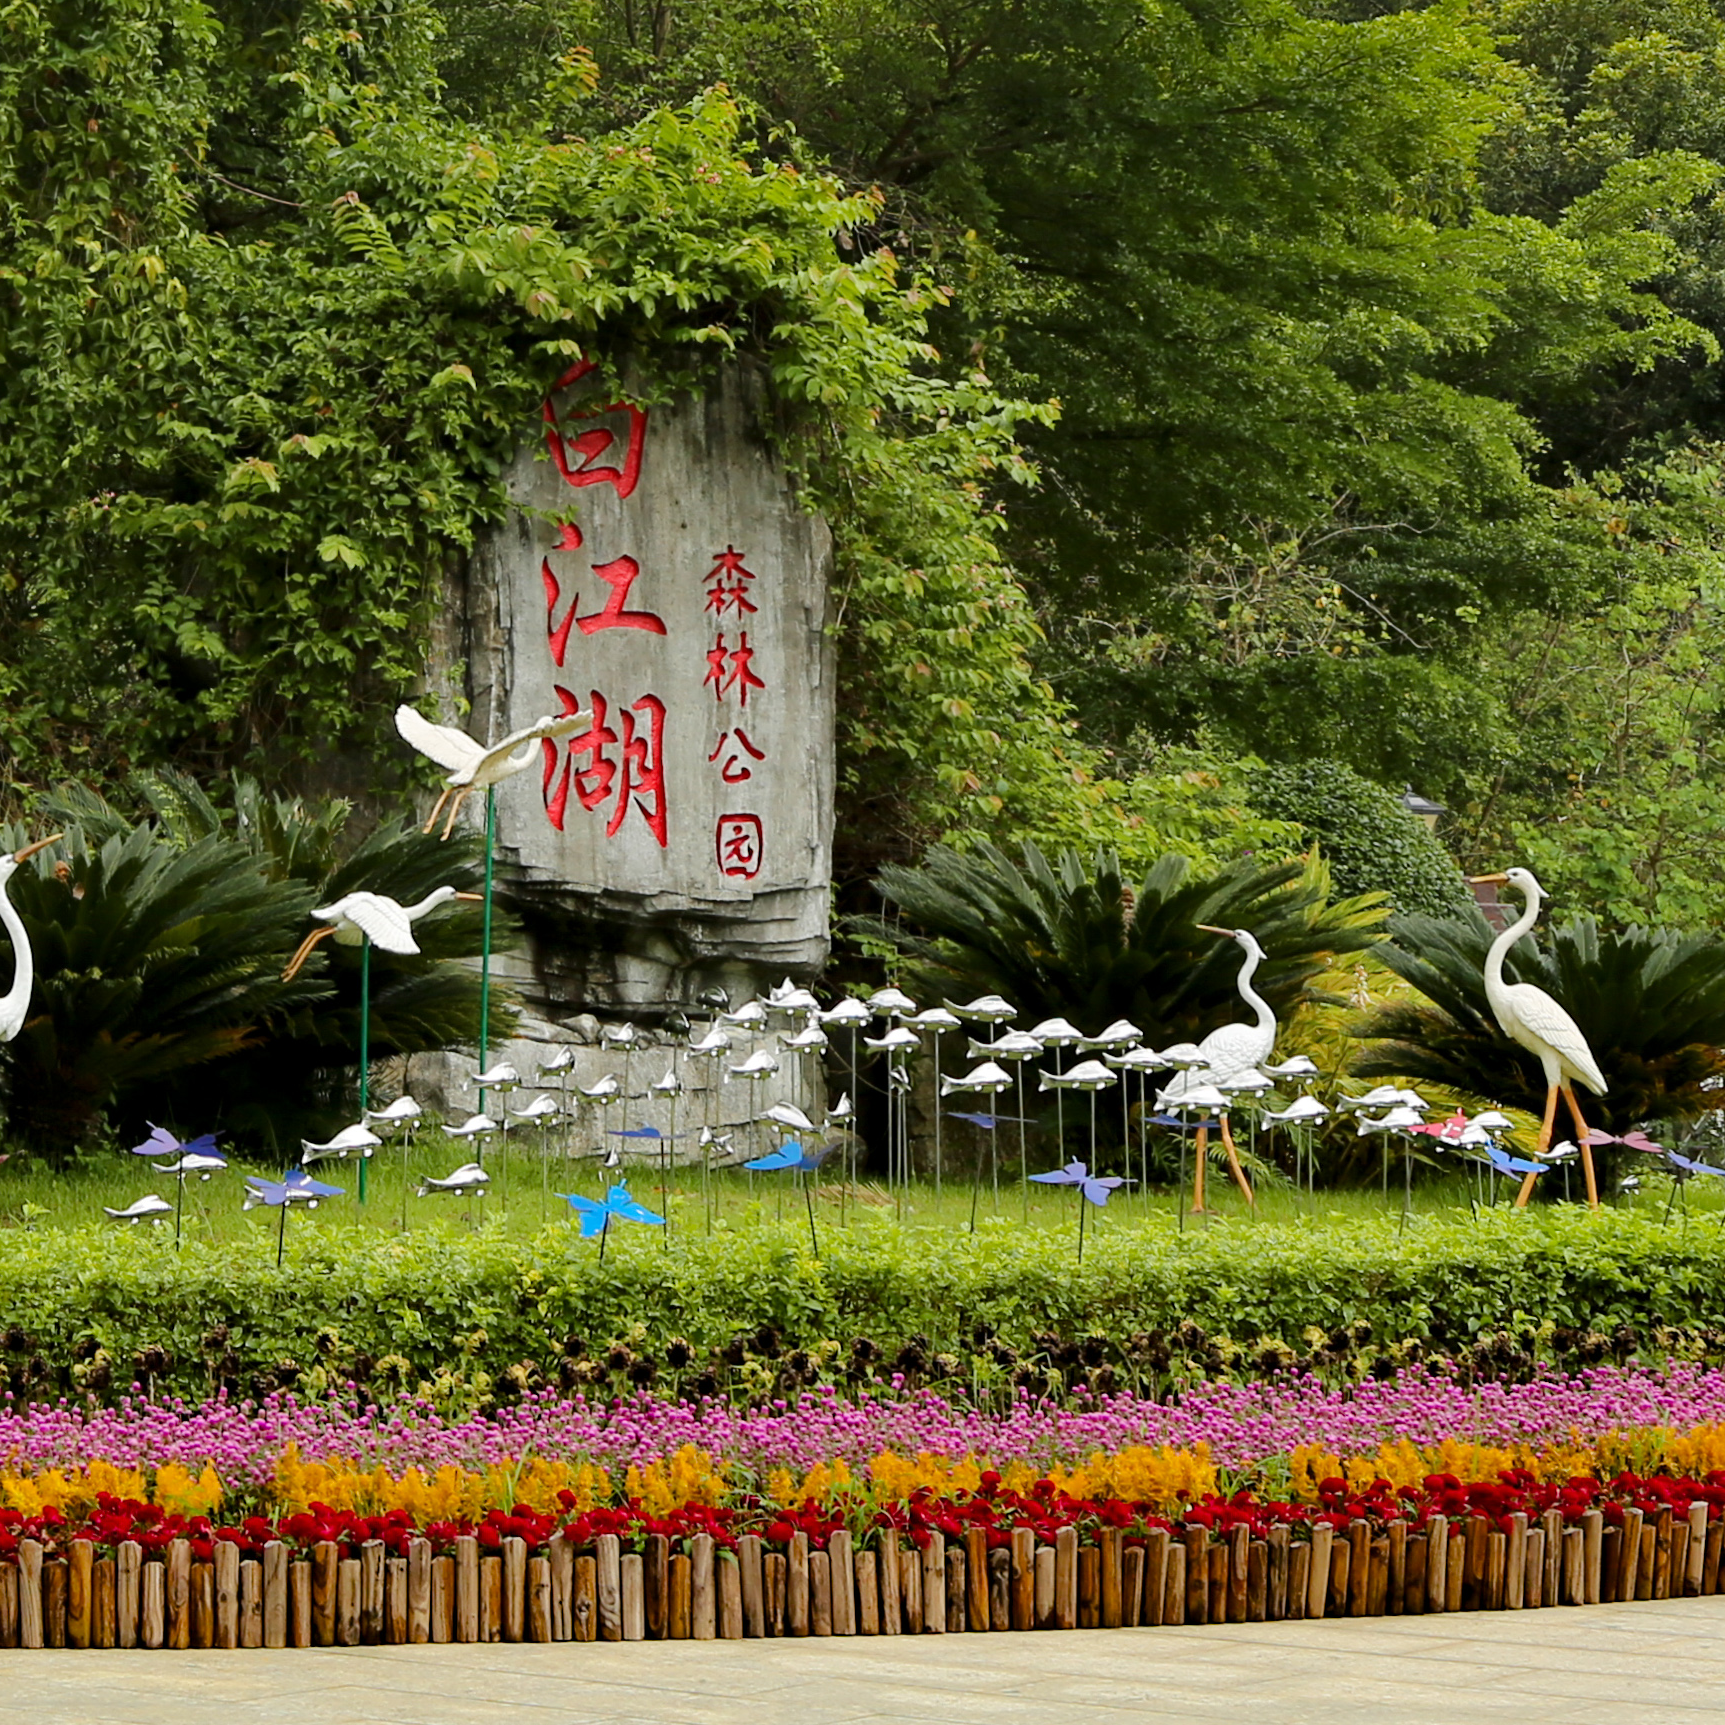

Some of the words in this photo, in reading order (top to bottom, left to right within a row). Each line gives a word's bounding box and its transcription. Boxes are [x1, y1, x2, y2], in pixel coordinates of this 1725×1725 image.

[542, 351, 668, 849] 白江湖
[703, 544, 766, 881] 森林公园
